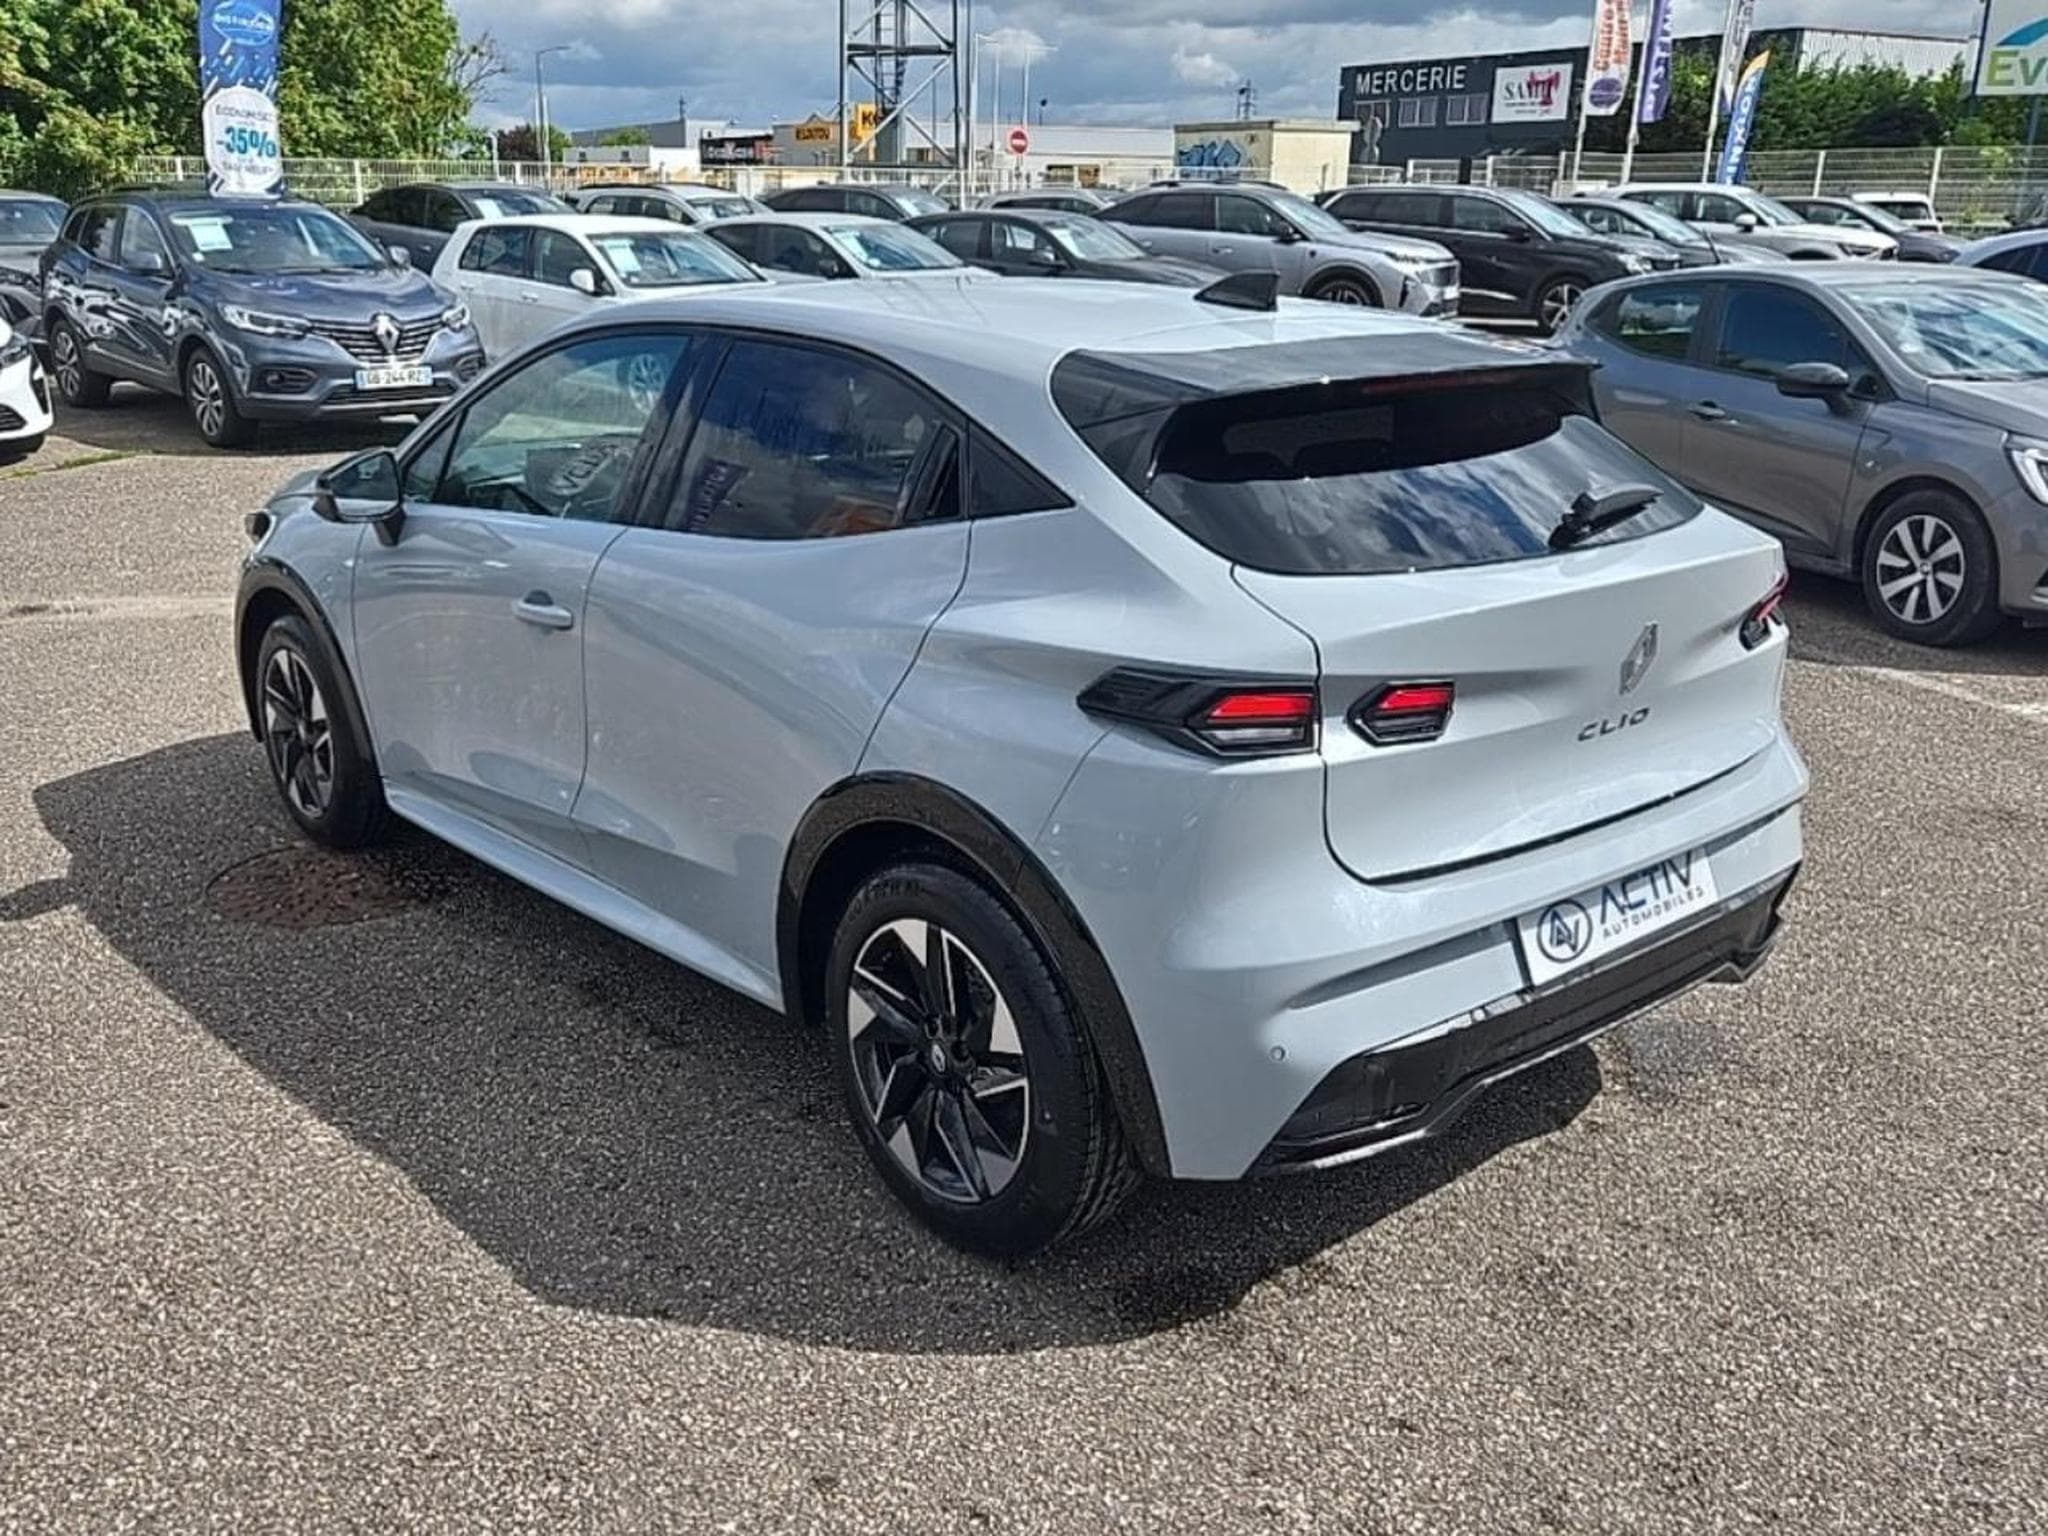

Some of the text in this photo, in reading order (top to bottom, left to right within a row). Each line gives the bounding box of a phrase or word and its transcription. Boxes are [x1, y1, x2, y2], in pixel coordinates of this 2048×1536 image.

[1355, 64, 1467, 95] MERCERIE
[1986, 50, 2048, 87] Ev
[216, 126, 277, 158] -35%
[1577, 707, 1650, 742] CLIO
[1599, 849, 1692, 925] ACTIV
[1602, 885, 1705, 939] AUTOMOBILES
